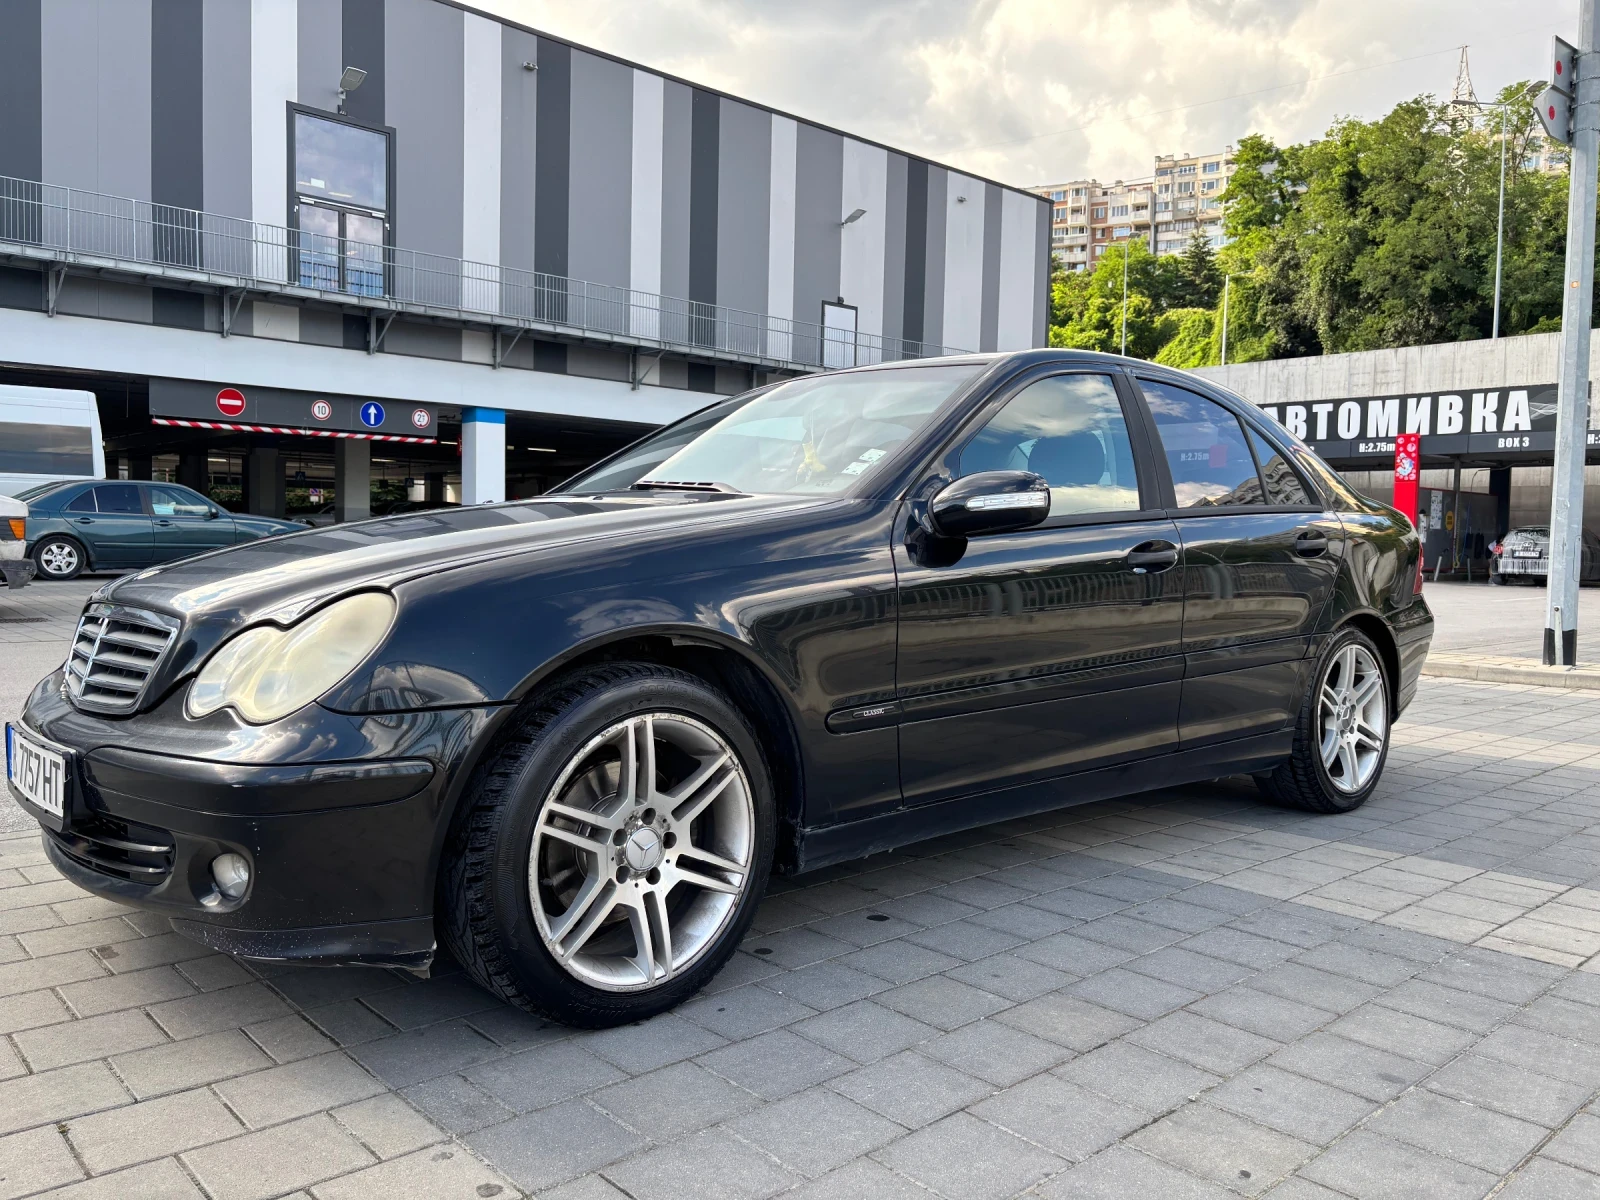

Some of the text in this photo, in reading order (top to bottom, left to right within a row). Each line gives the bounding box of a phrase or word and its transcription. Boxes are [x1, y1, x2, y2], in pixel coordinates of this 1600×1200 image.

[317, 405, 327, 416] 10
[1522, 436, 1530, 447] 3
[1359, 442, 1396, 453] H:2.75m
[863, 708, 885, 717] CLASSIC
